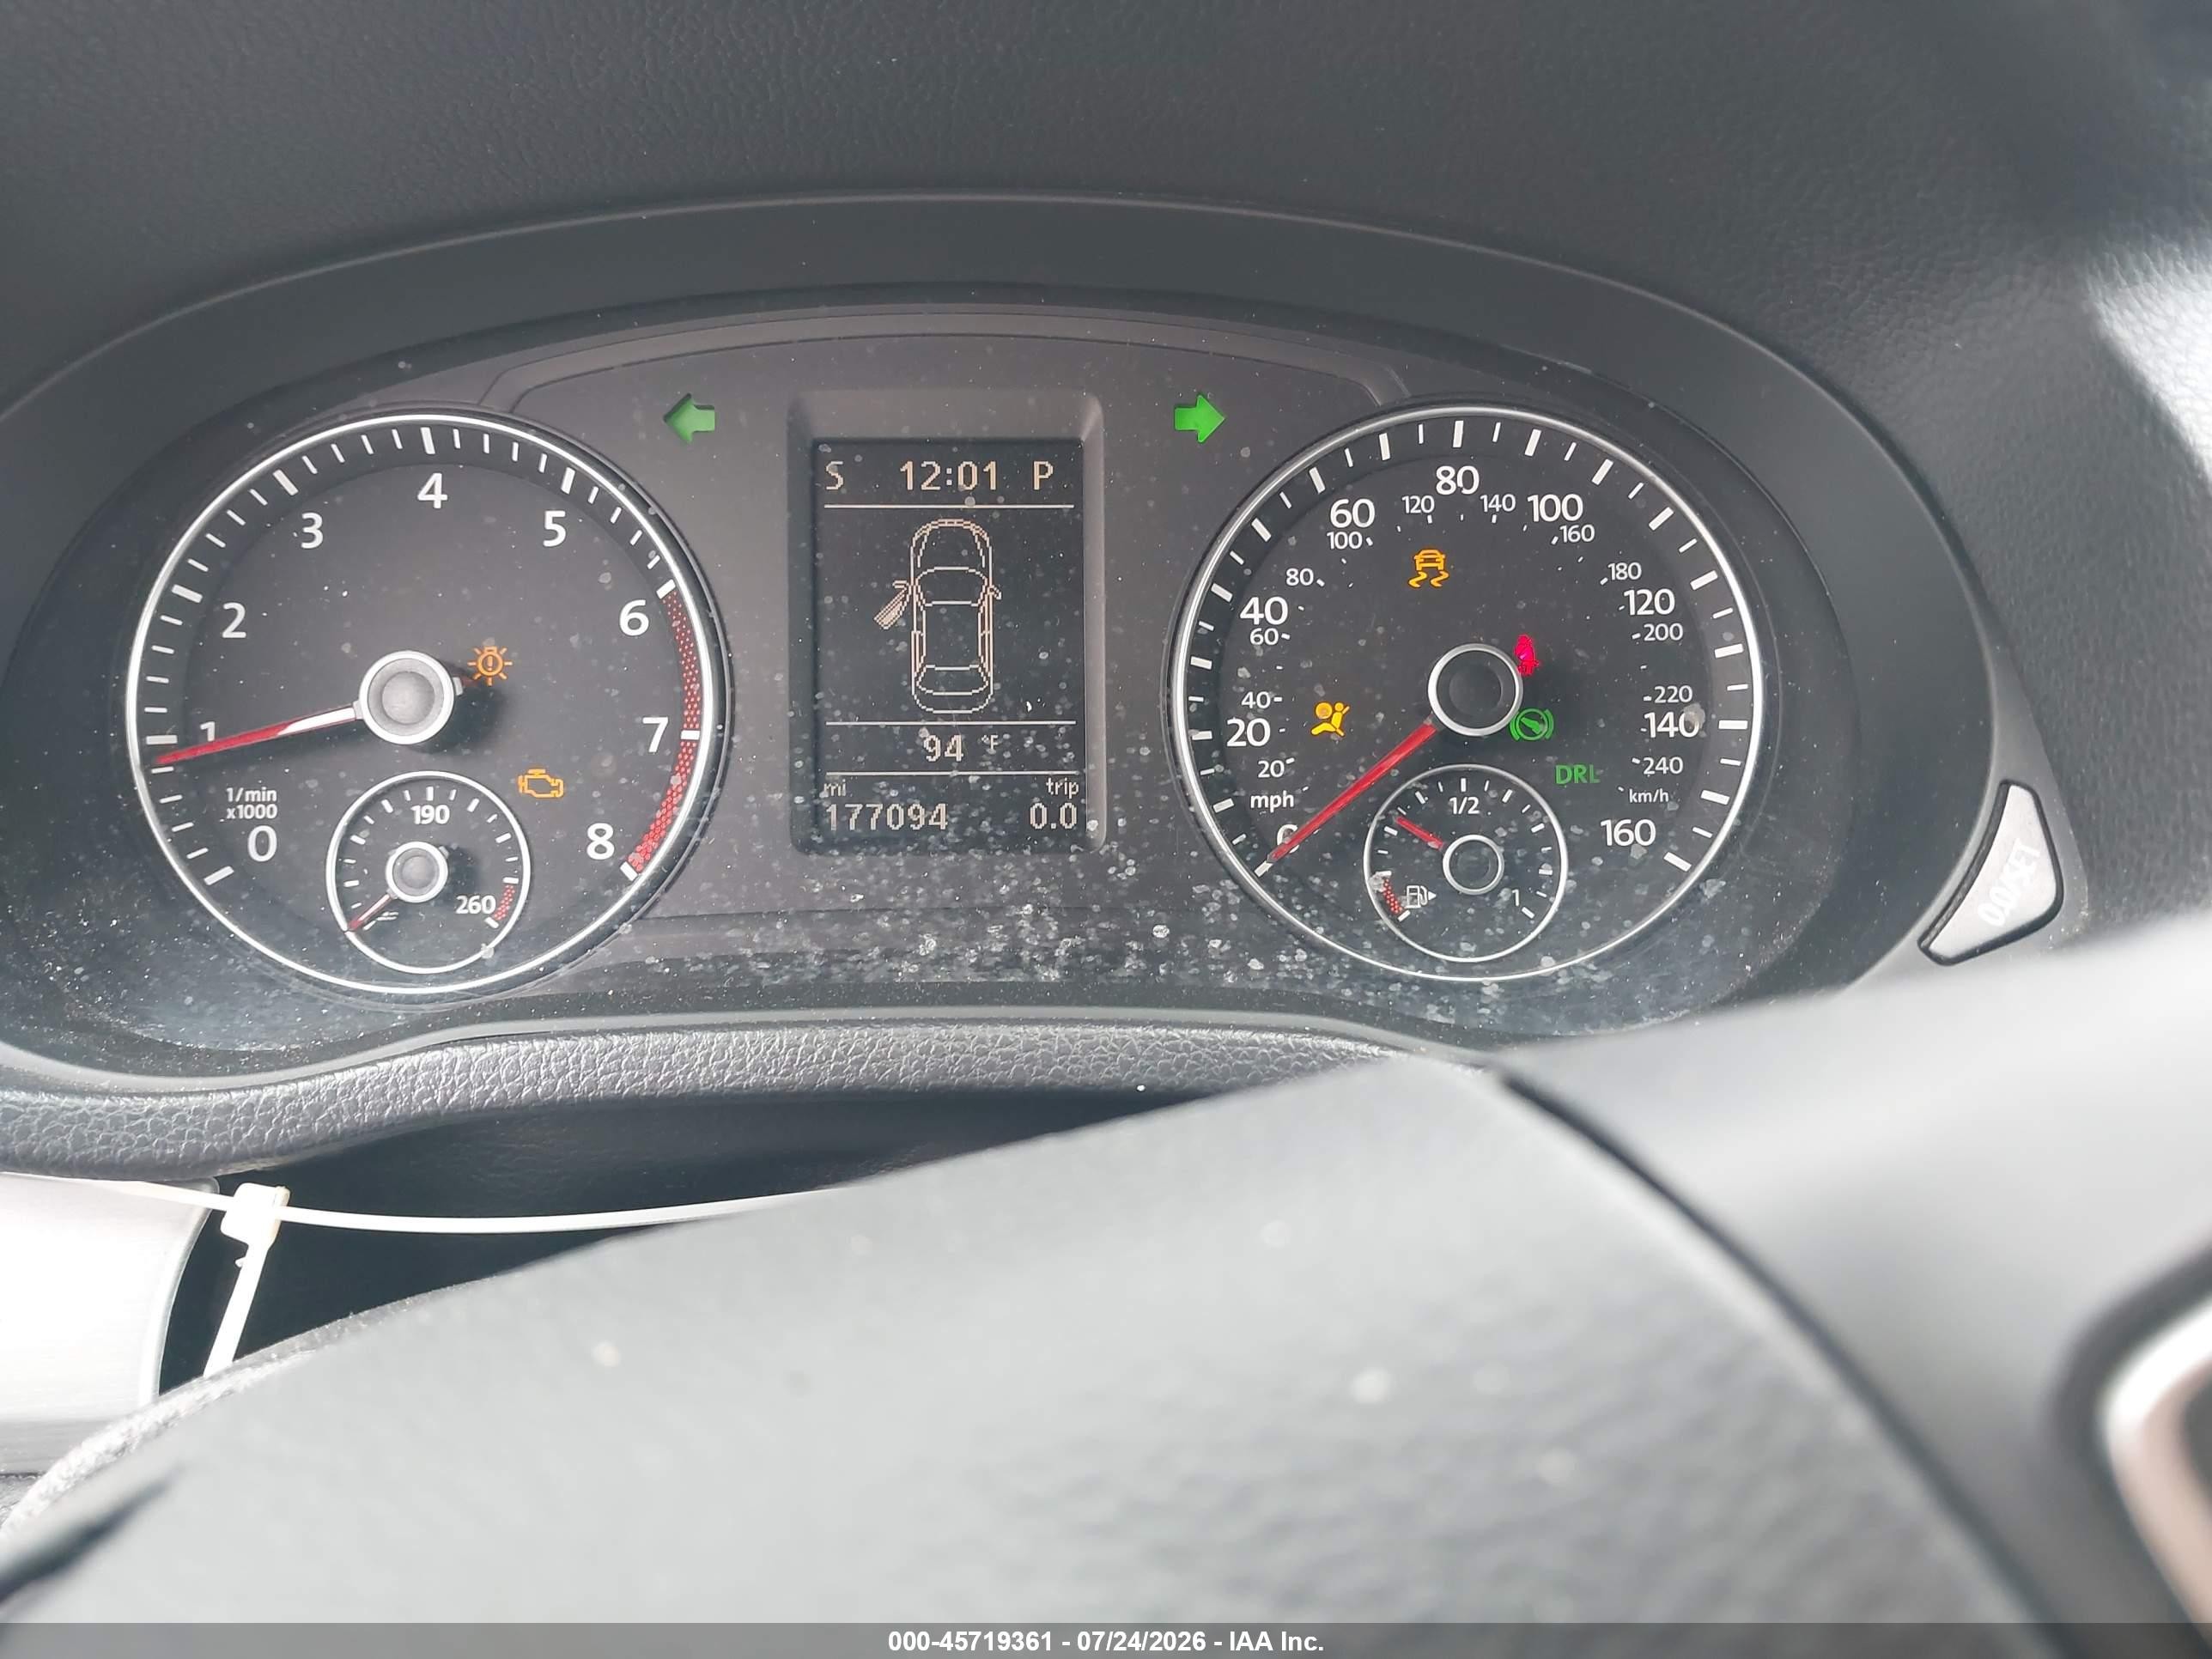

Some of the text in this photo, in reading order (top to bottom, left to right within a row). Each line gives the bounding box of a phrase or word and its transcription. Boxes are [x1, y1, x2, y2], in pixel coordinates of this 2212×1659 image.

[826, 461, 1053, 489] S 12:01 P
[1437, 466, 1479, 495] 80
[418, 473, 447, 508] 4
[1331, 499, 1375, 527] 60
[1402, 495, 1434, 513] 120
[1480, 495, 1516, 512] 140
[1528, 494, 1583, 521] 100
[301, 513, 323, 548] 3
[544, 511, 565, 546] 5
[1560, 525, 1595, 542] 160
[1327, 532, 1362, 549] 100
[1286, 568, 1313, 586] 80
[1608, 562, 1641, 580] 180
[1240, 597, 1288, 624] 40
[1627, 589, 1674, 615] 120
[222, 603, 246, 638] 2
[620, 600, 648, 635] 6
[1250, 629, 1279, 645] 60
[1644, 623, 1683, 641] 200
[1242, 692, 1270, 708] 40
[1655, 685, 1692, 702] 220
[643, 717, 668, 752] 7
[1227, 718, 1270, 746] 20
[1646, 712, 1699, 738] 140
[923, 734, 963, 762] 94
[1259, 761, 1284, 777] 20
[1555, 764, 1601, 784] DRL
[1644, 757, 1683, 774] 240
[227, 787, 276, 801] 1/min
[823, 779, 846, 797] mi
[1046, 777, 1079, 799] trip
[1630, 788, 1668, 802] km/h
[227, 804, 277, 818] x1000
[1251, 791, 1293, 812] mph
[1450, 797, 1480, 814] 1/2
[411, 805, 449, 824] 190
[825, 804, 948, 830] 177094
[1030, 803, 1076, 829] 0.0
[587, 823, 614, 860] 8
[1601, 819, 1656, 846] 160
[248, 826, 276, 861] 0
[456, 896, 495, 914] 260
[1512, 889, 1520, 907] 1
